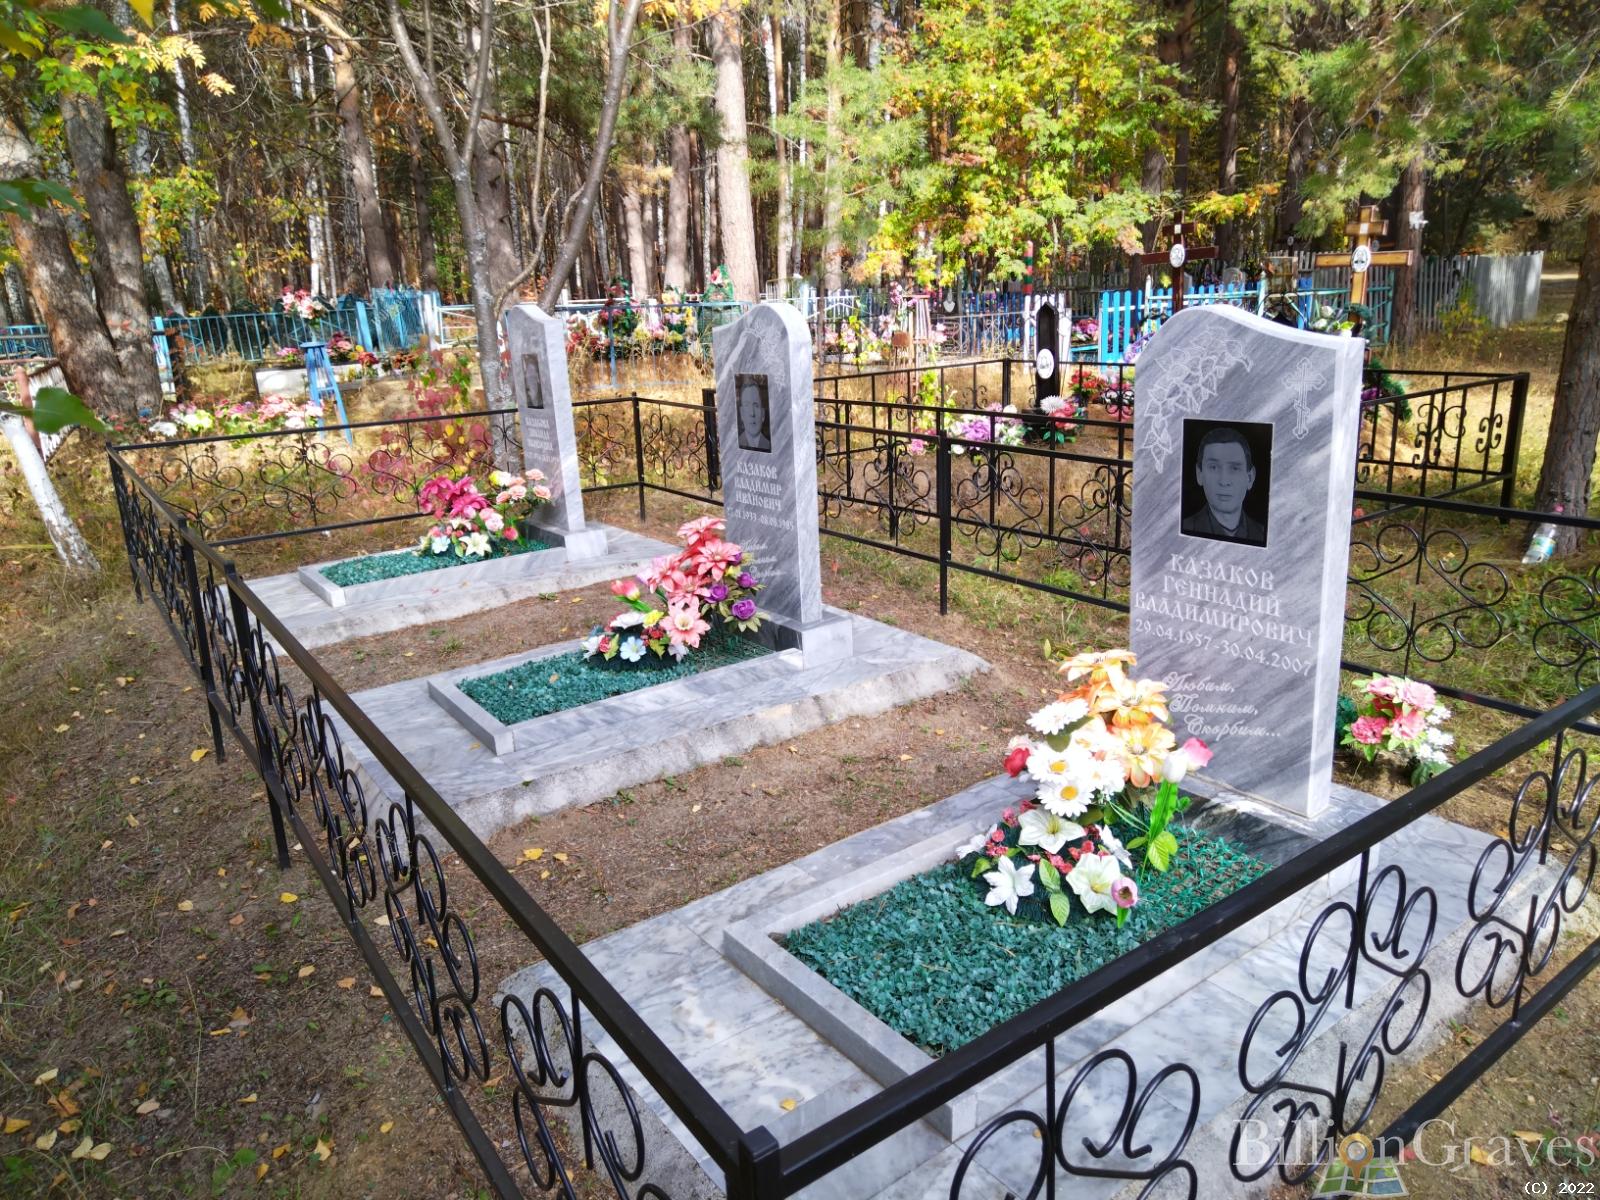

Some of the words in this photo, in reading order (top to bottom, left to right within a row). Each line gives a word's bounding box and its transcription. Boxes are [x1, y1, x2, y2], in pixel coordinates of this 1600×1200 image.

[736, 461, 778, 480] КАЗАКОВ
[735, 491, 782, 512] ИВАНОВИЧ
[1170, 553, 1275, 591] КАЗАКОВ
[1162, 575, 1282, 617] ГЕННАДИЙ
[1134, 591, 1314, 649] ВЛАДИМИРОВИЧ
[1161, 671, 1236, 694] Любим,
[1168, 693, 1259, 716] Помним,
